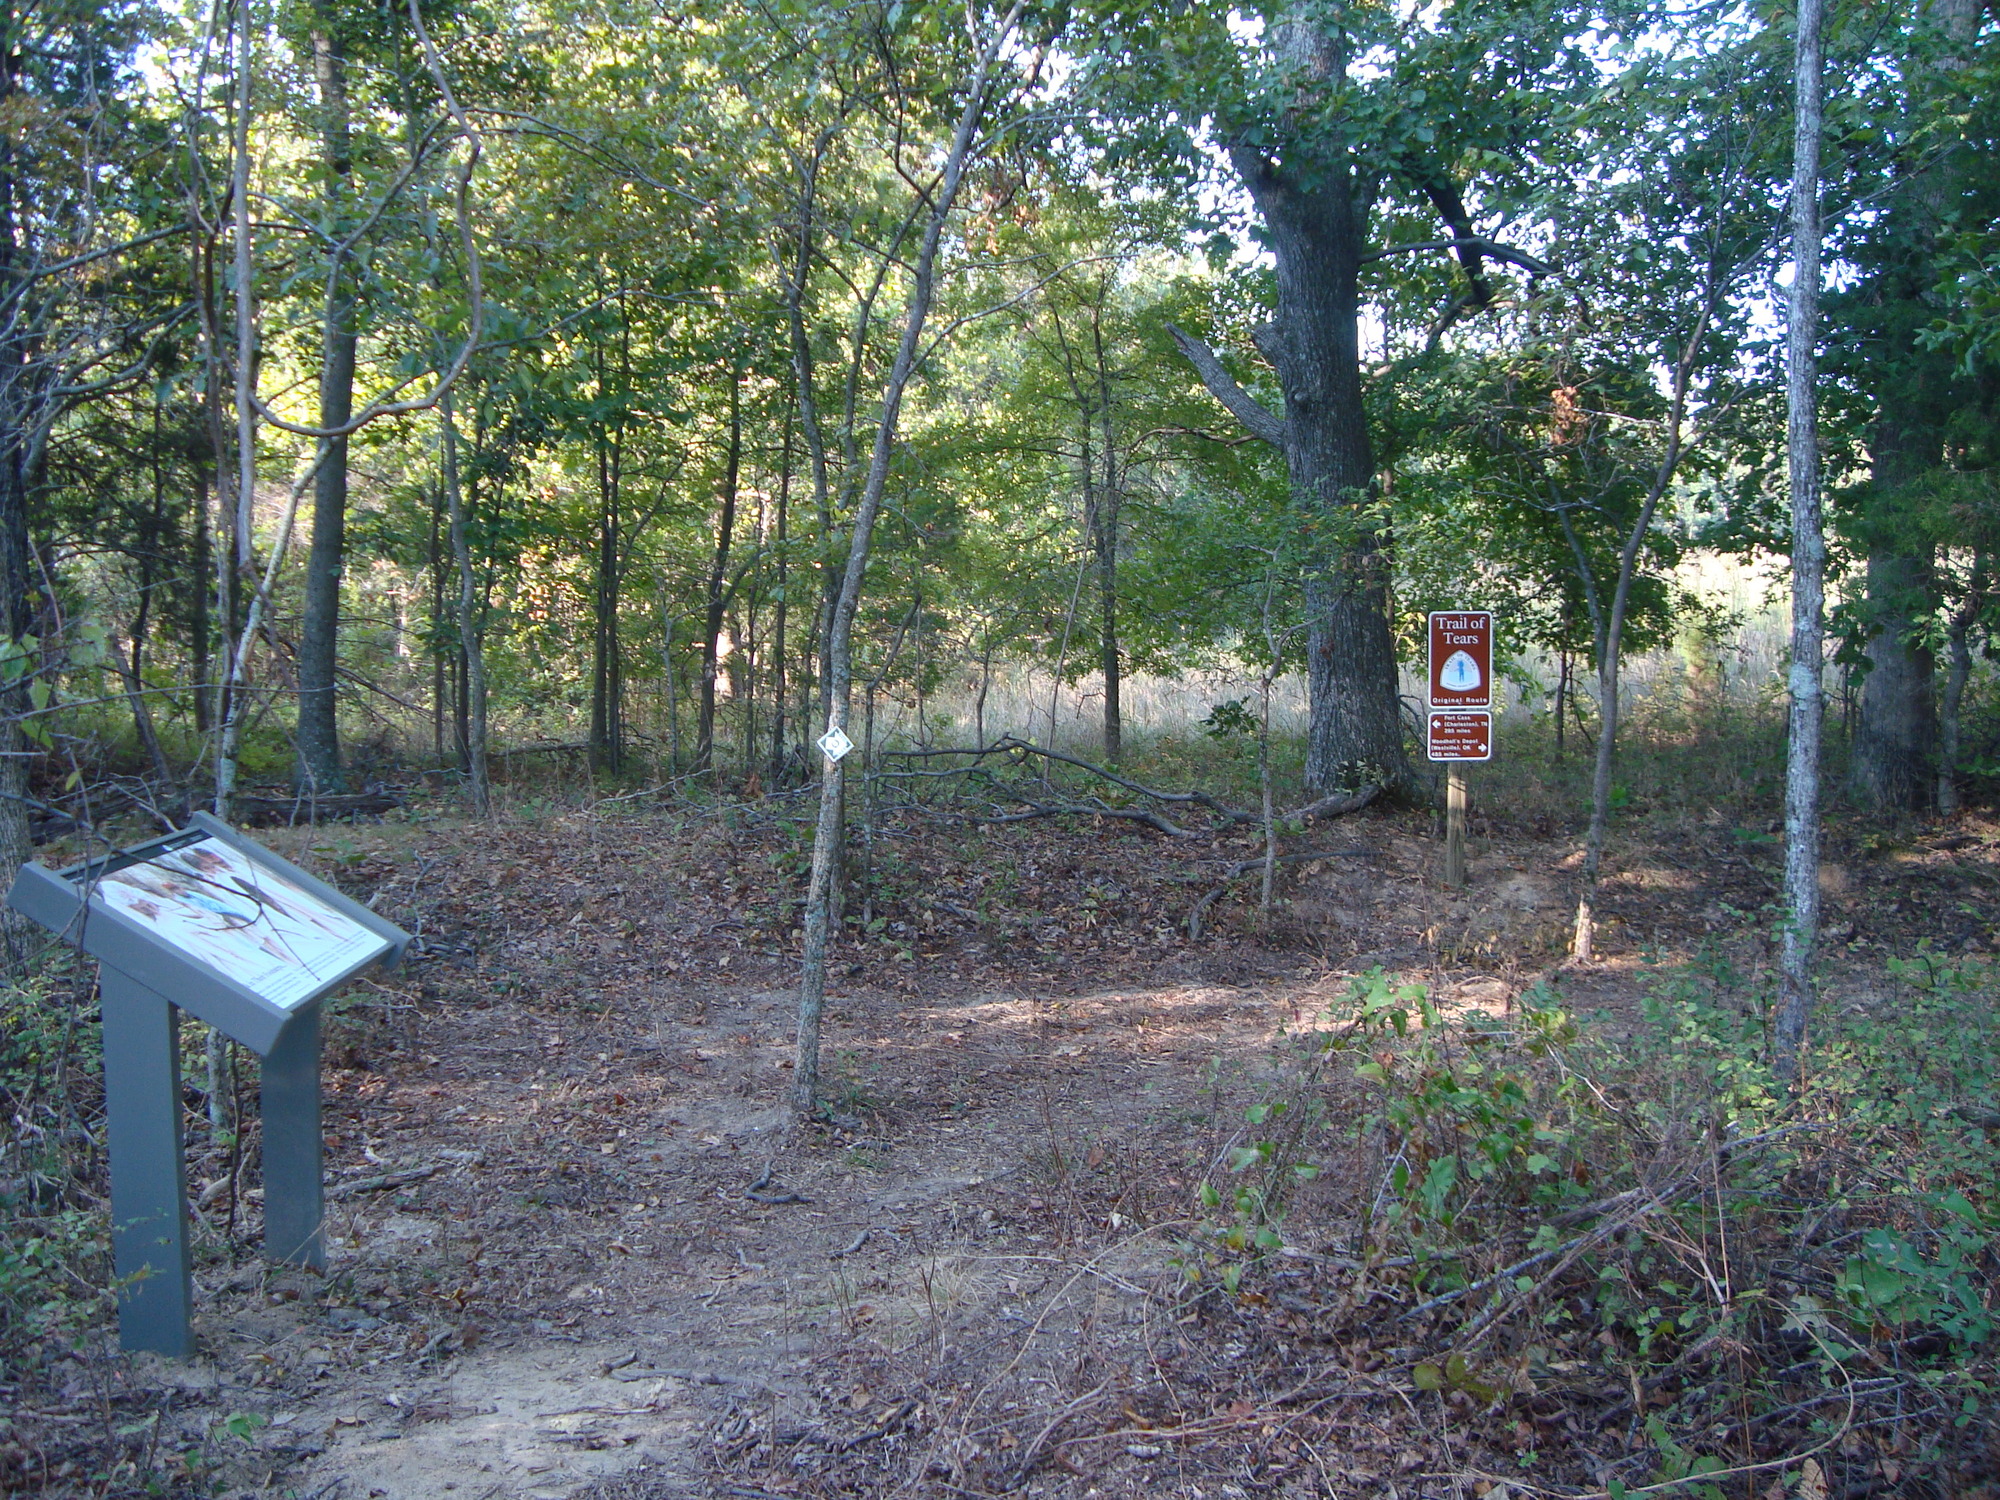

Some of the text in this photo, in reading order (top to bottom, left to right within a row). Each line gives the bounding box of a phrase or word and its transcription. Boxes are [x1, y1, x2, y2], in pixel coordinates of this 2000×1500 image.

[1436, 615, 1485, 629] Trail of
[1443, 632, 1478, 644] Tears
[1432, 697, 1462, 705] Original
